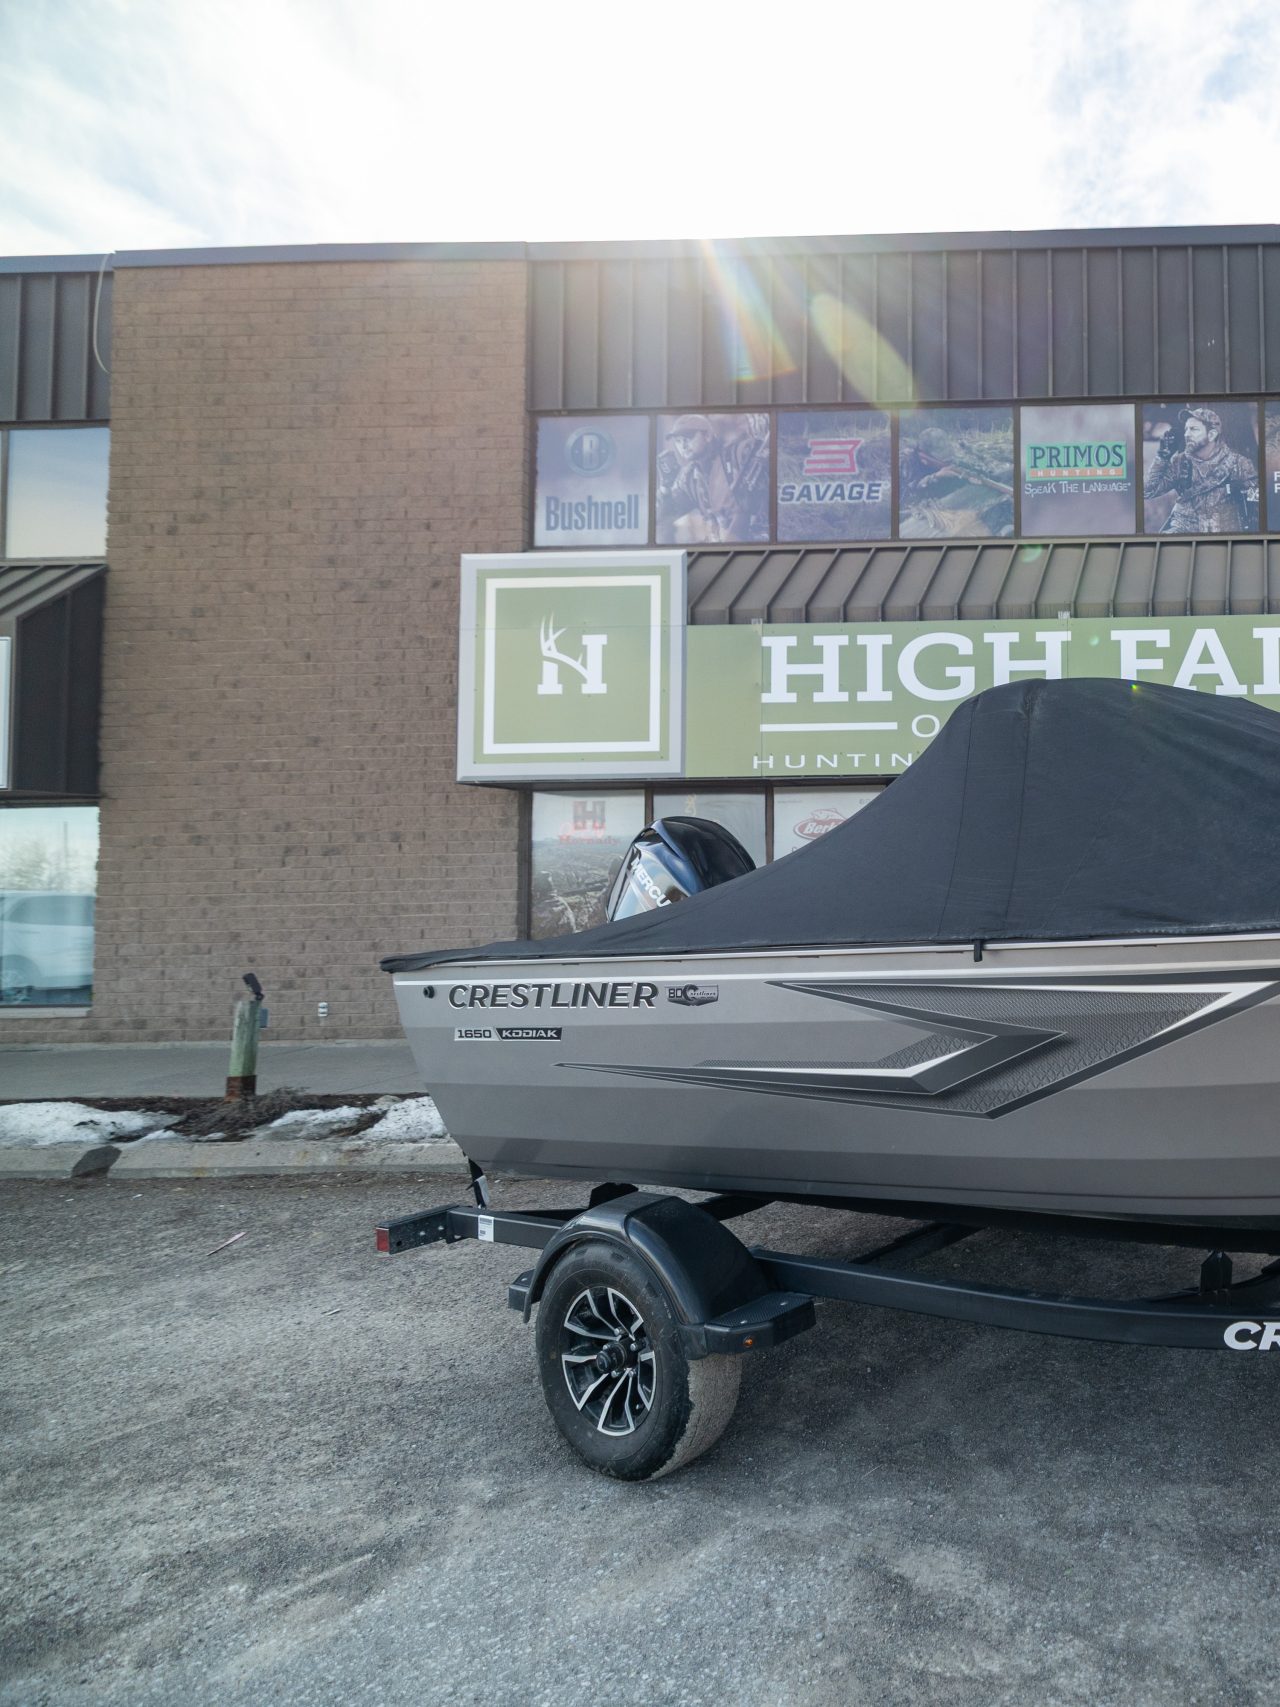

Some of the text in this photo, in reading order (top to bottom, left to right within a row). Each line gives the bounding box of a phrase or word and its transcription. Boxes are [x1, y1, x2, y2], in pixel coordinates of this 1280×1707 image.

[1030, 445, 1124, 468] PRIMOS
[1037, 469, 1116, 477] HUNTING
[779, 482, 882, 502] SAVAGE
[545, 494, 639, 531] Bushnell
[761, 630, 1072, 703] HIGH
[448, 982, 660, 1009] CRESTLINER
[457, 1028, 559, 1040] 1650 KODIAK
